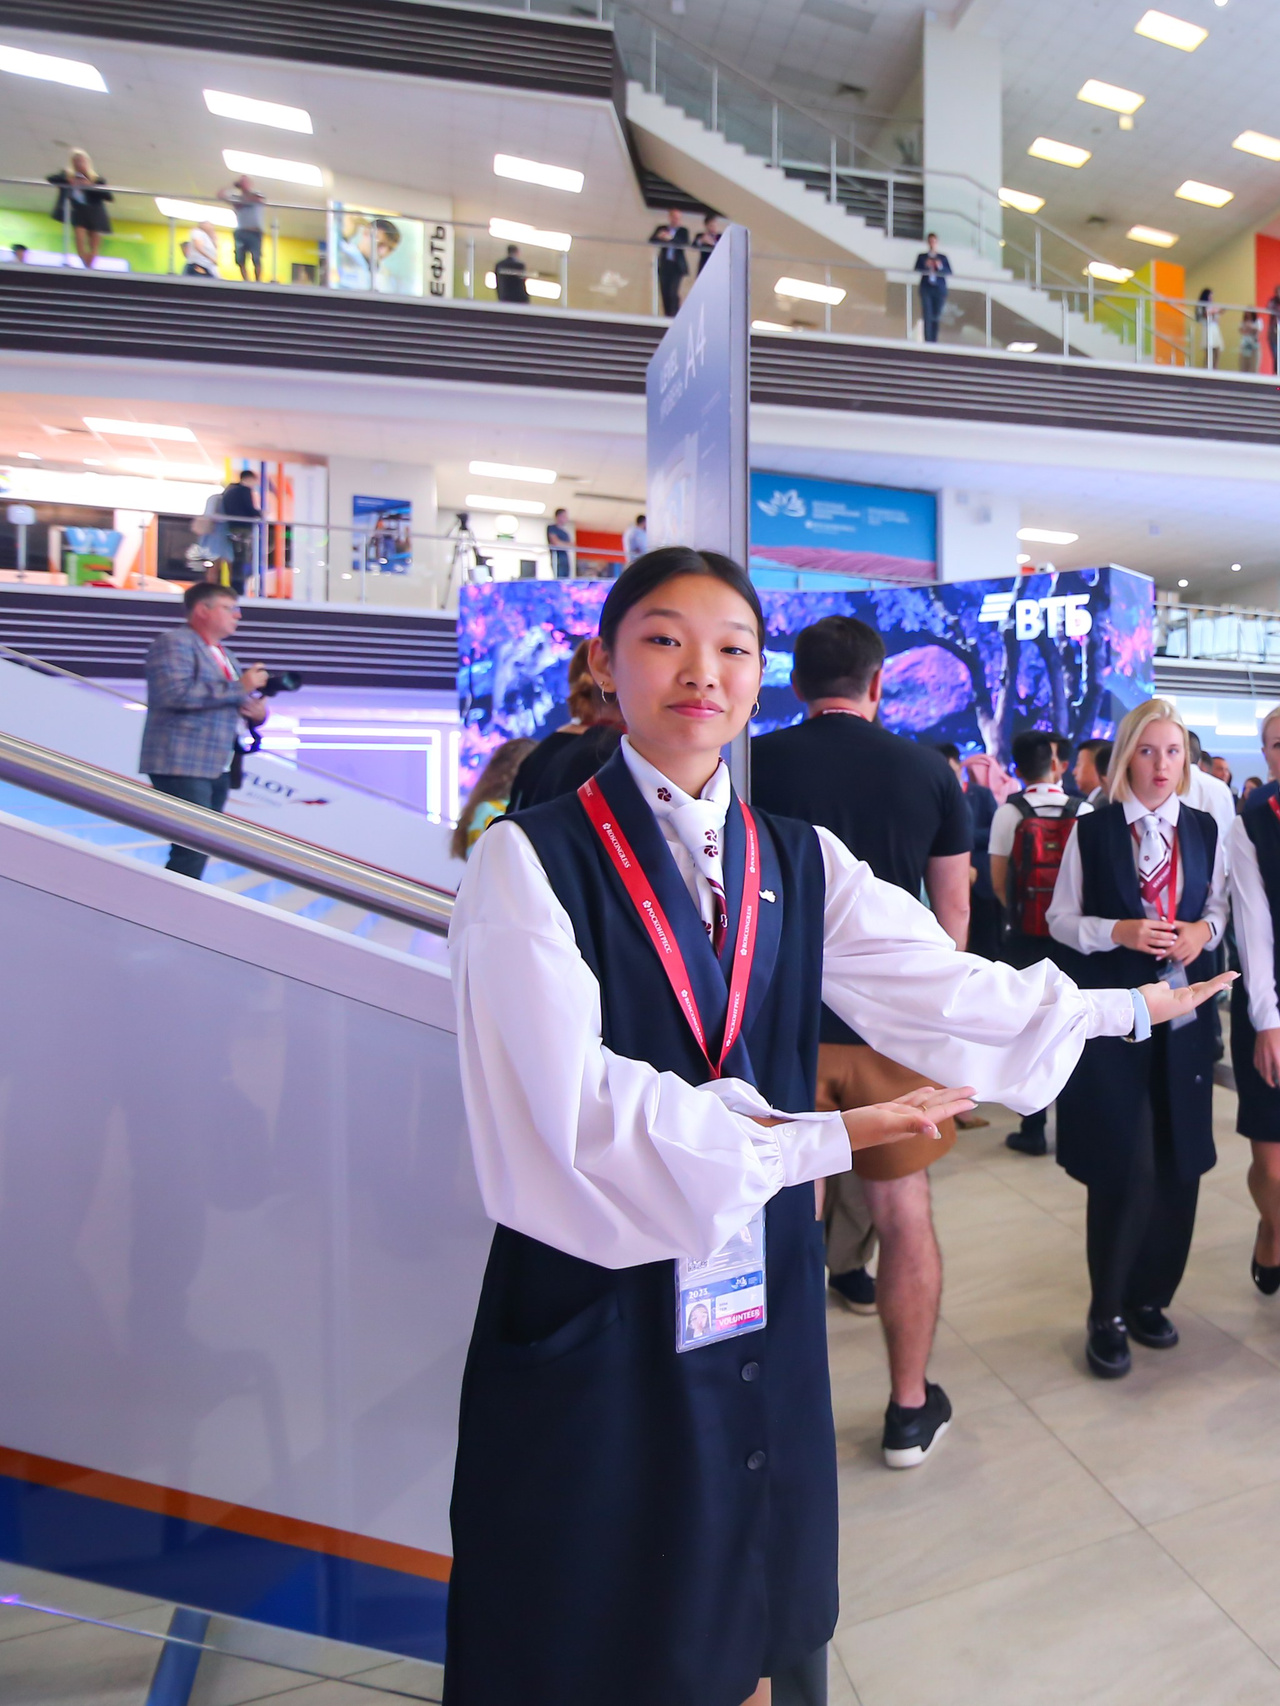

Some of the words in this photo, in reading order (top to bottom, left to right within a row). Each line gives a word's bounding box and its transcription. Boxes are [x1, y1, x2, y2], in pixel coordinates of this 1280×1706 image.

[1015, 593, 1092, 641] ВТБ
[606, 829, 631, 869] ROSCONGRESS
[646, 907, 673, 954] РОСКОНГРЕСС
[689, 1288, 708, 1299] 2023
[720, 1309, 760, 1326] VOLUNTEER
